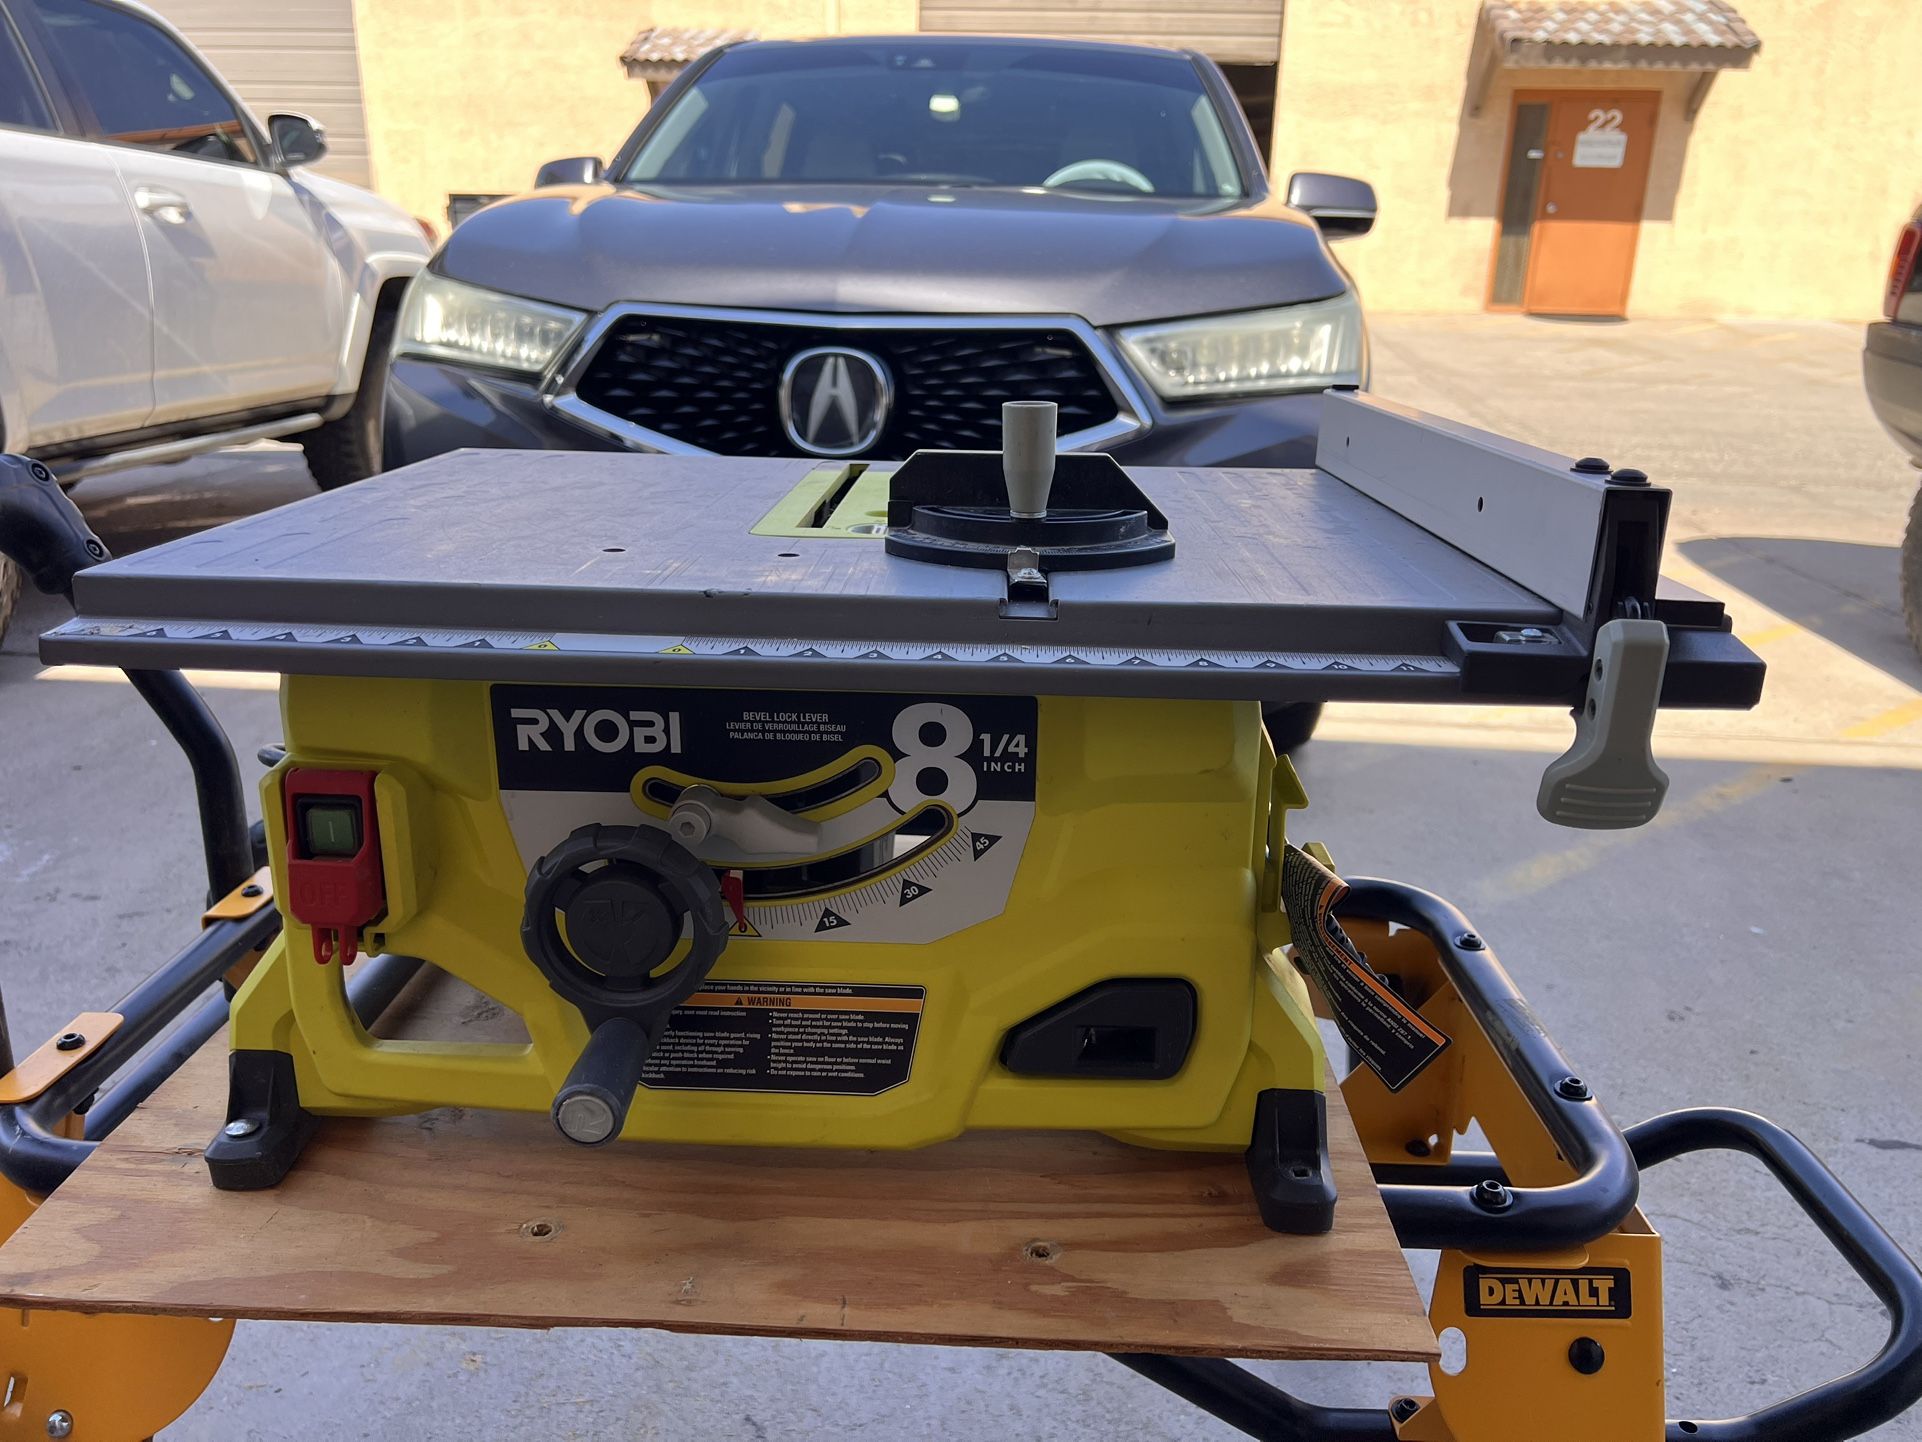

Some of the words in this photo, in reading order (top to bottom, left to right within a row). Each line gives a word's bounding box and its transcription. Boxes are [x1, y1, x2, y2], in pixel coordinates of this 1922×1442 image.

[1585, 109, 1623, 133] 22
[743, 711, 772, 721] BEVEL
[774, 712, 798, 722] LOCK
[800, 713, 829, 722] LEVER
[510, 708, 682, 754] RYOBI
[726, 721, 751, 730] LEVIER
[753, 722, 763, 730] DE
[764, 722, 818, 731] VERROUILLAGE
[820, 724, 847, 732] BISEAU
[729, 731, 763, 740] PALANCA
[765, 732, 775, 740] DE
[776, 732, 810, 741] BLOQUEO
[811, 733, 821, 741] DE
[822, 734, 843, 742] BISEL
[888, 702, 977, 815] 8
[979, 733, 1028, 758] 1/4
[983, 761, 1025, 773] INCH
[975, 836, 990, 851] 45
[902, 886, 918, 898] 30
[823, 916, 838, 926] 15
[747, 997, 791, 1007] WARNING
